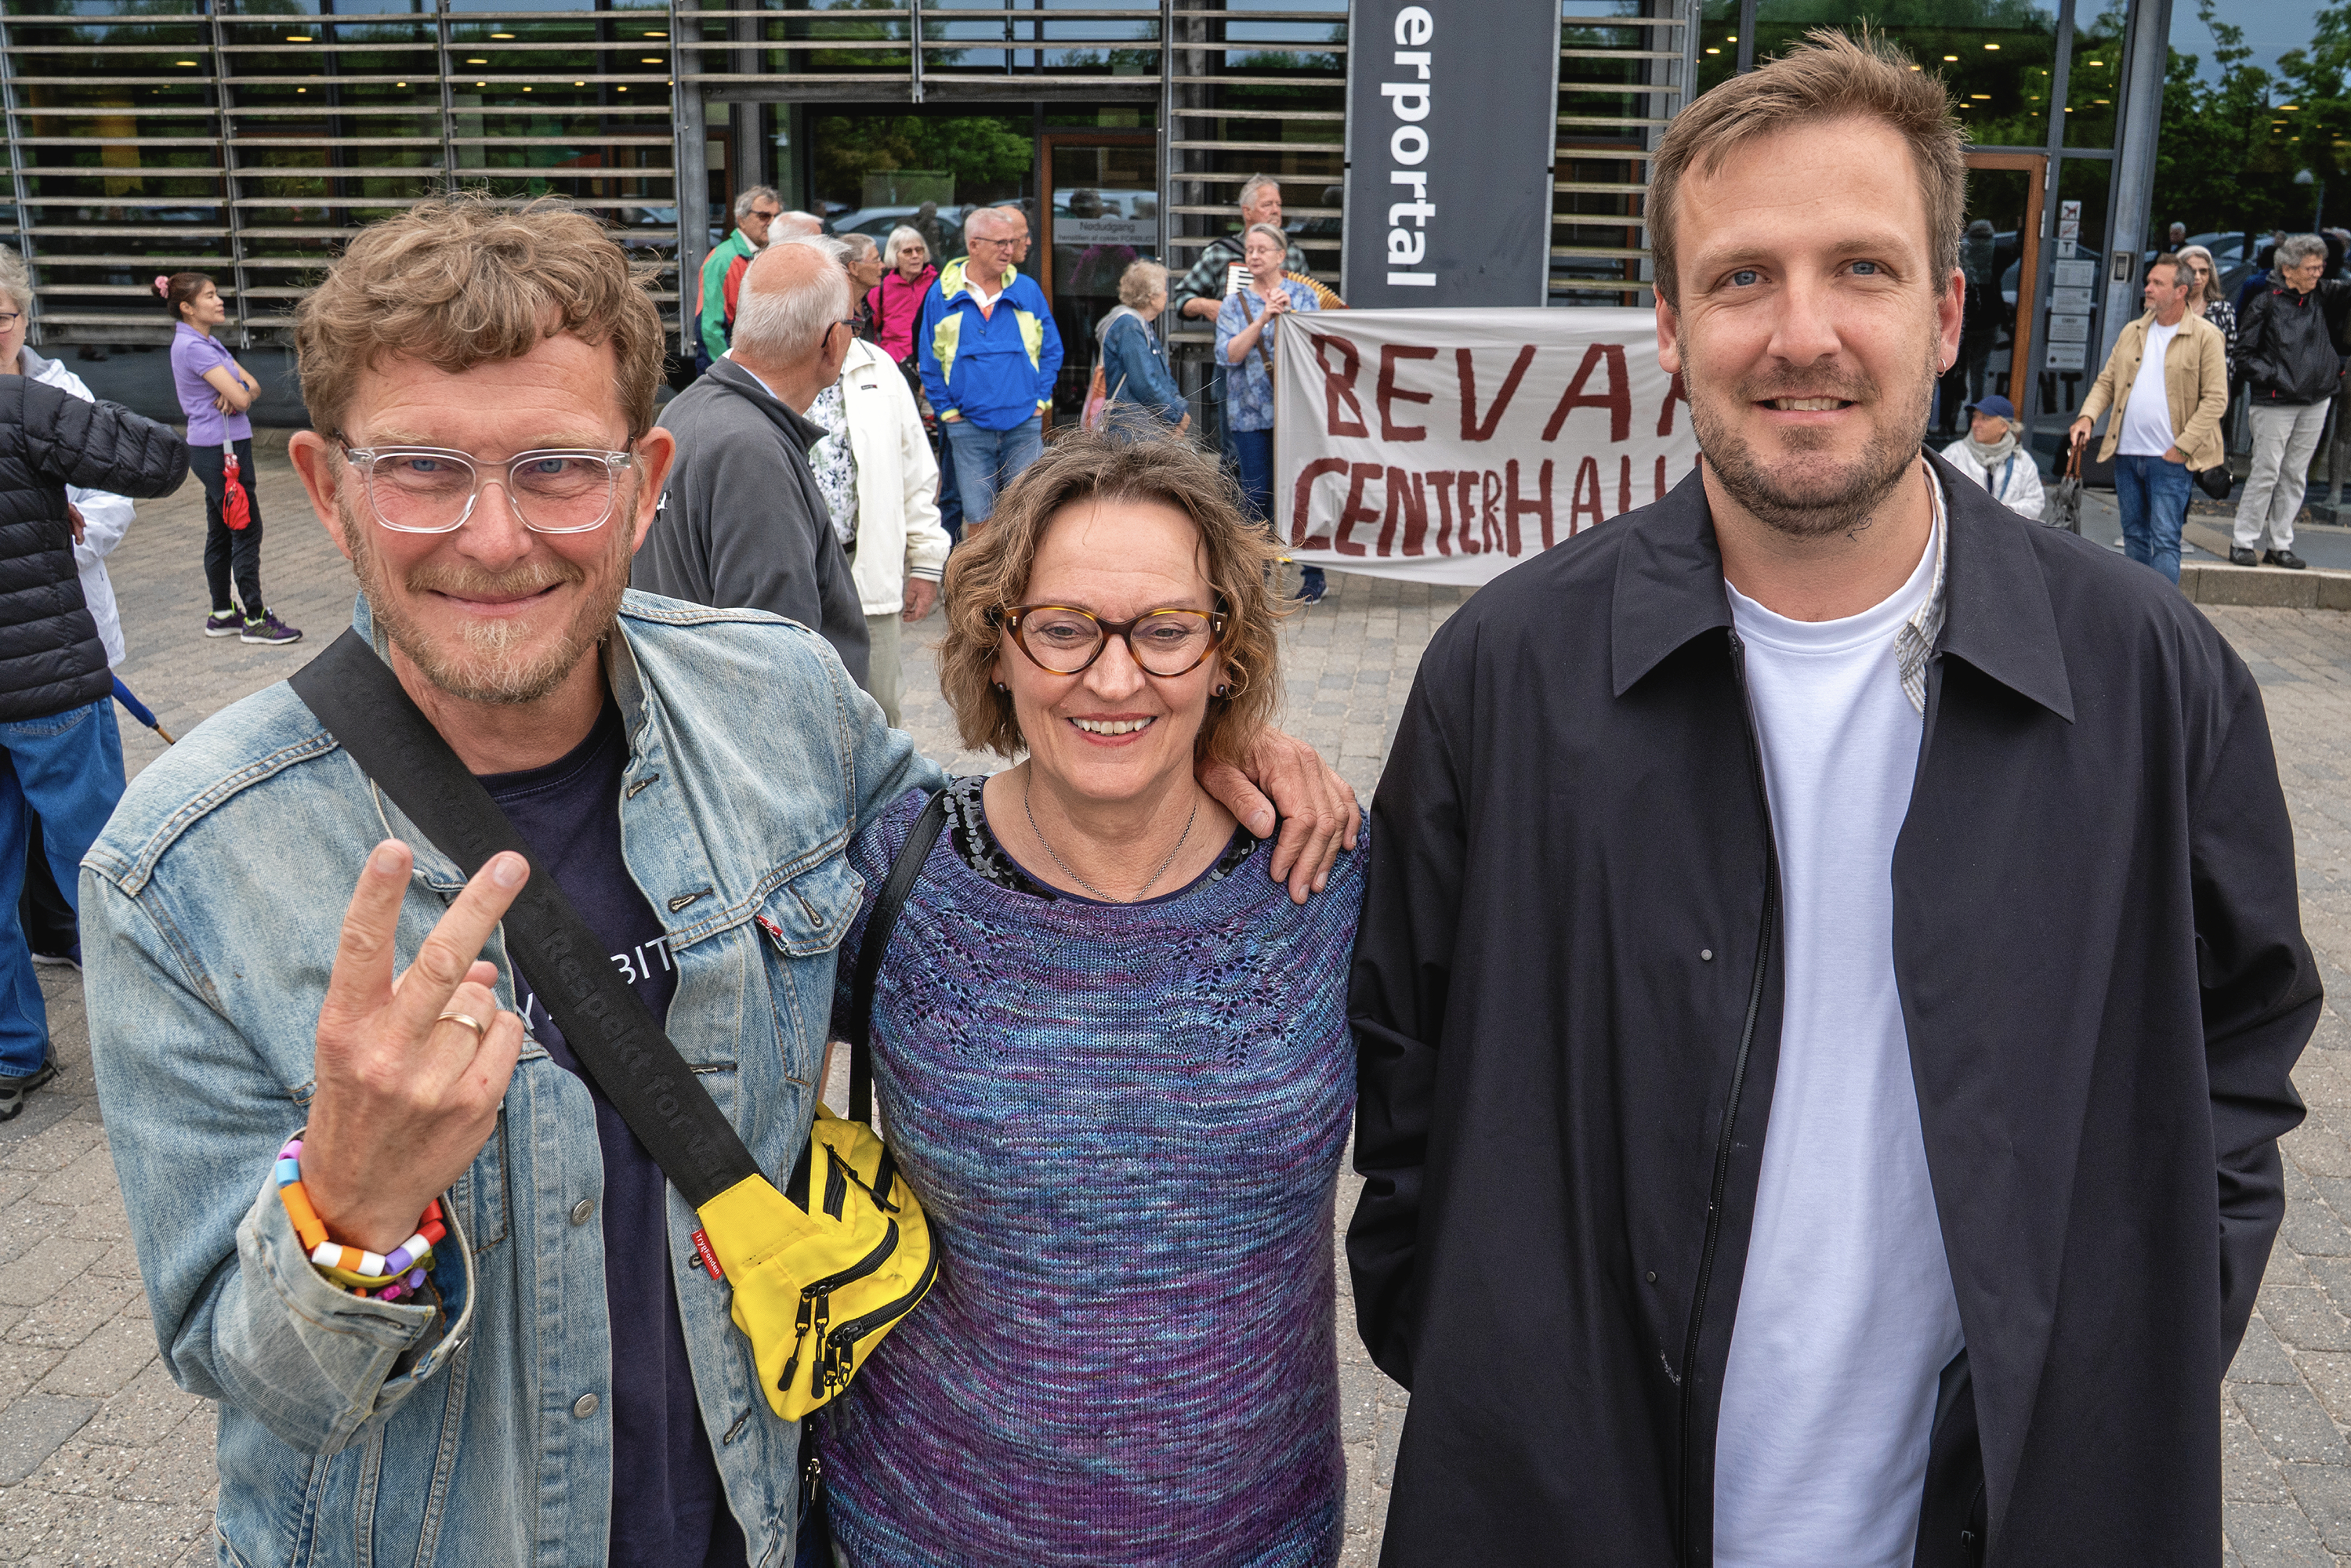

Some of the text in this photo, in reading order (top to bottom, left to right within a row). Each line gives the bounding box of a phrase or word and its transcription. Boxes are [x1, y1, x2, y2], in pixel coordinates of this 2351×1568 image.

[1381, 0, 1436, 287] erportal
[1079, 222, 1136, 234] Nødudgang
[1291, 452, 1701, 557] CENTERHA
[537, 925, 655, 1077] Respekt
[643, 1072, 693, 1128] for
[695, 1233, 720, 1275] TrygFonden
